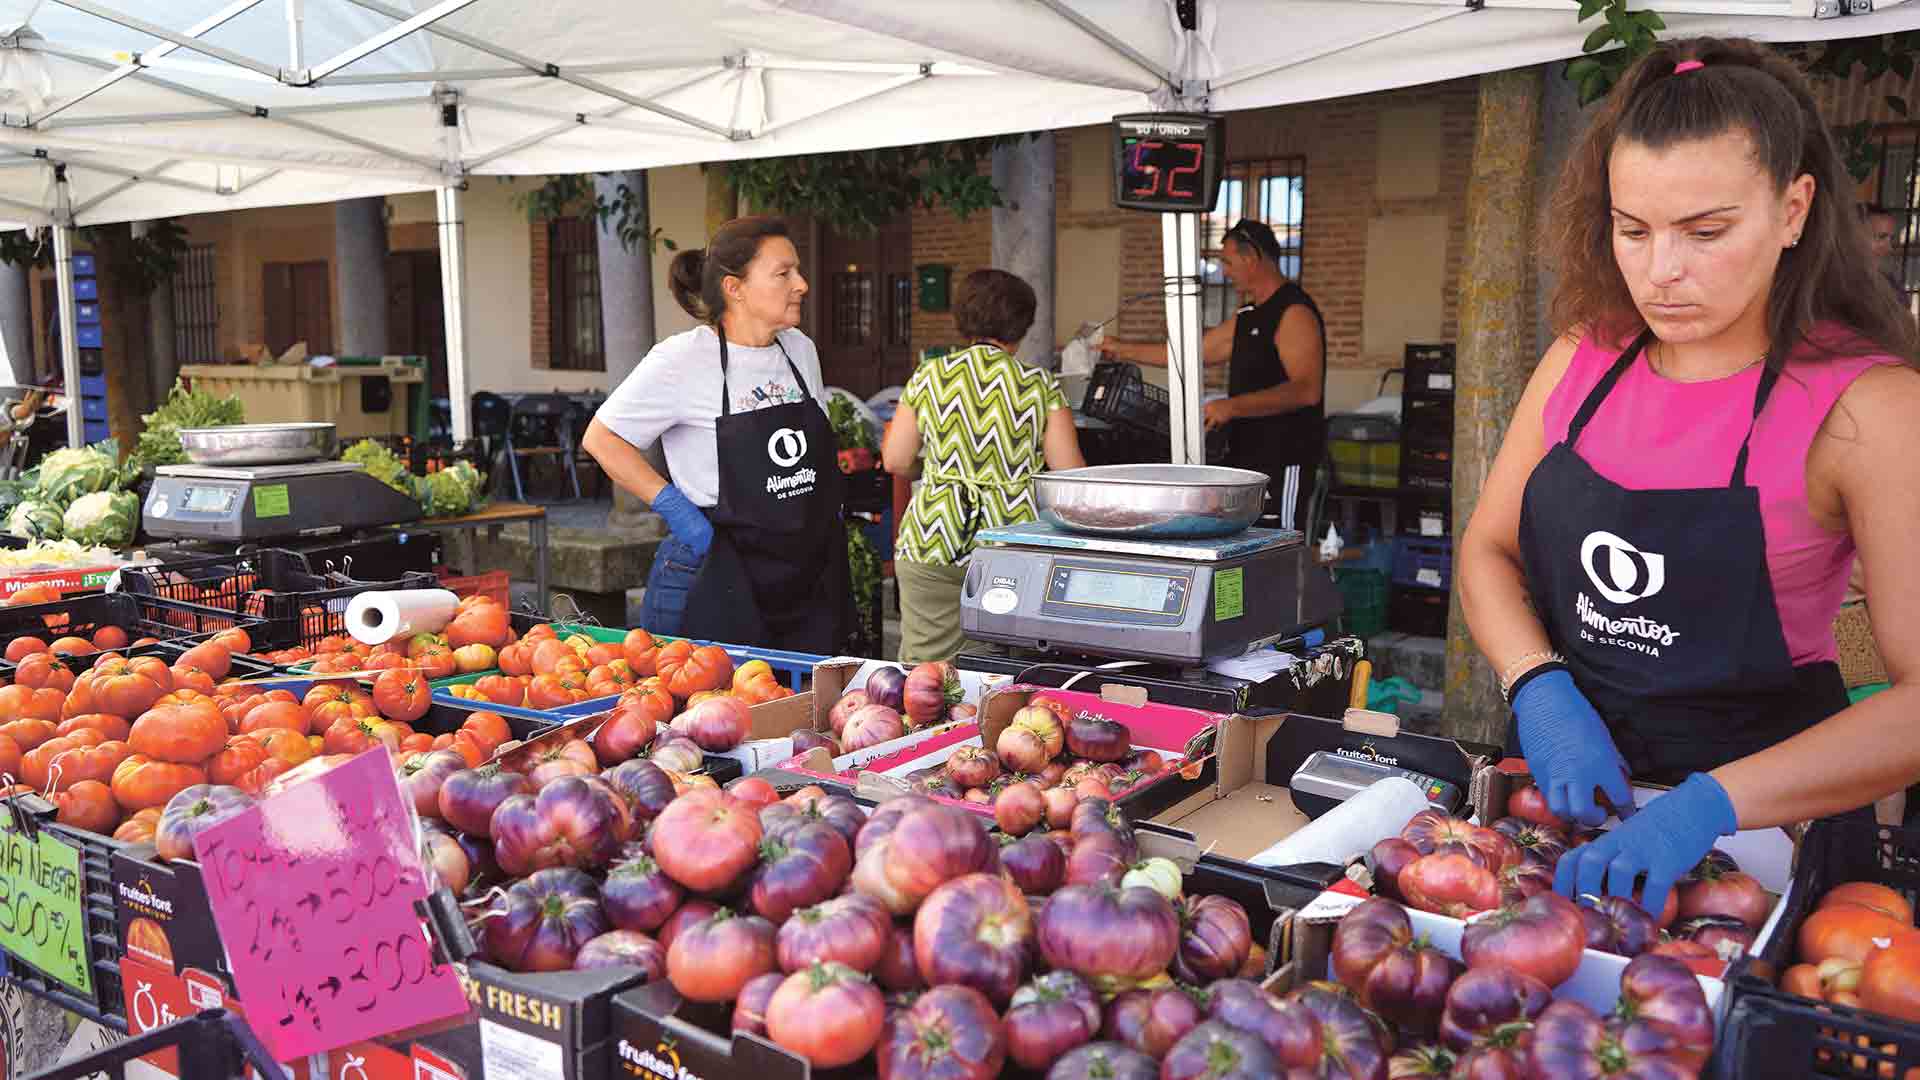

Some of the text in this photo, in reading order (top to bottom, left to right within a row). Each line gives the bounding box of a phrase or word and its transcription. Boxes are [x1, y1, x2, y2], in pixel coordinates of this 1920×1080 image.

[1135, 143, 1202, 197] 52
[993, 577, 1016, 586] DIBAL
[1575, 591, 1681, 646] Alimentos
[1580, 628, 1660, 657] DE SEGOVIA
[1336, 747, 1398, 766] fruites font
[119, 881, 173, 914] fruites font
[486, 984, 561, 1031] FRESH
[619, 1039, 675, 1080] fruites
